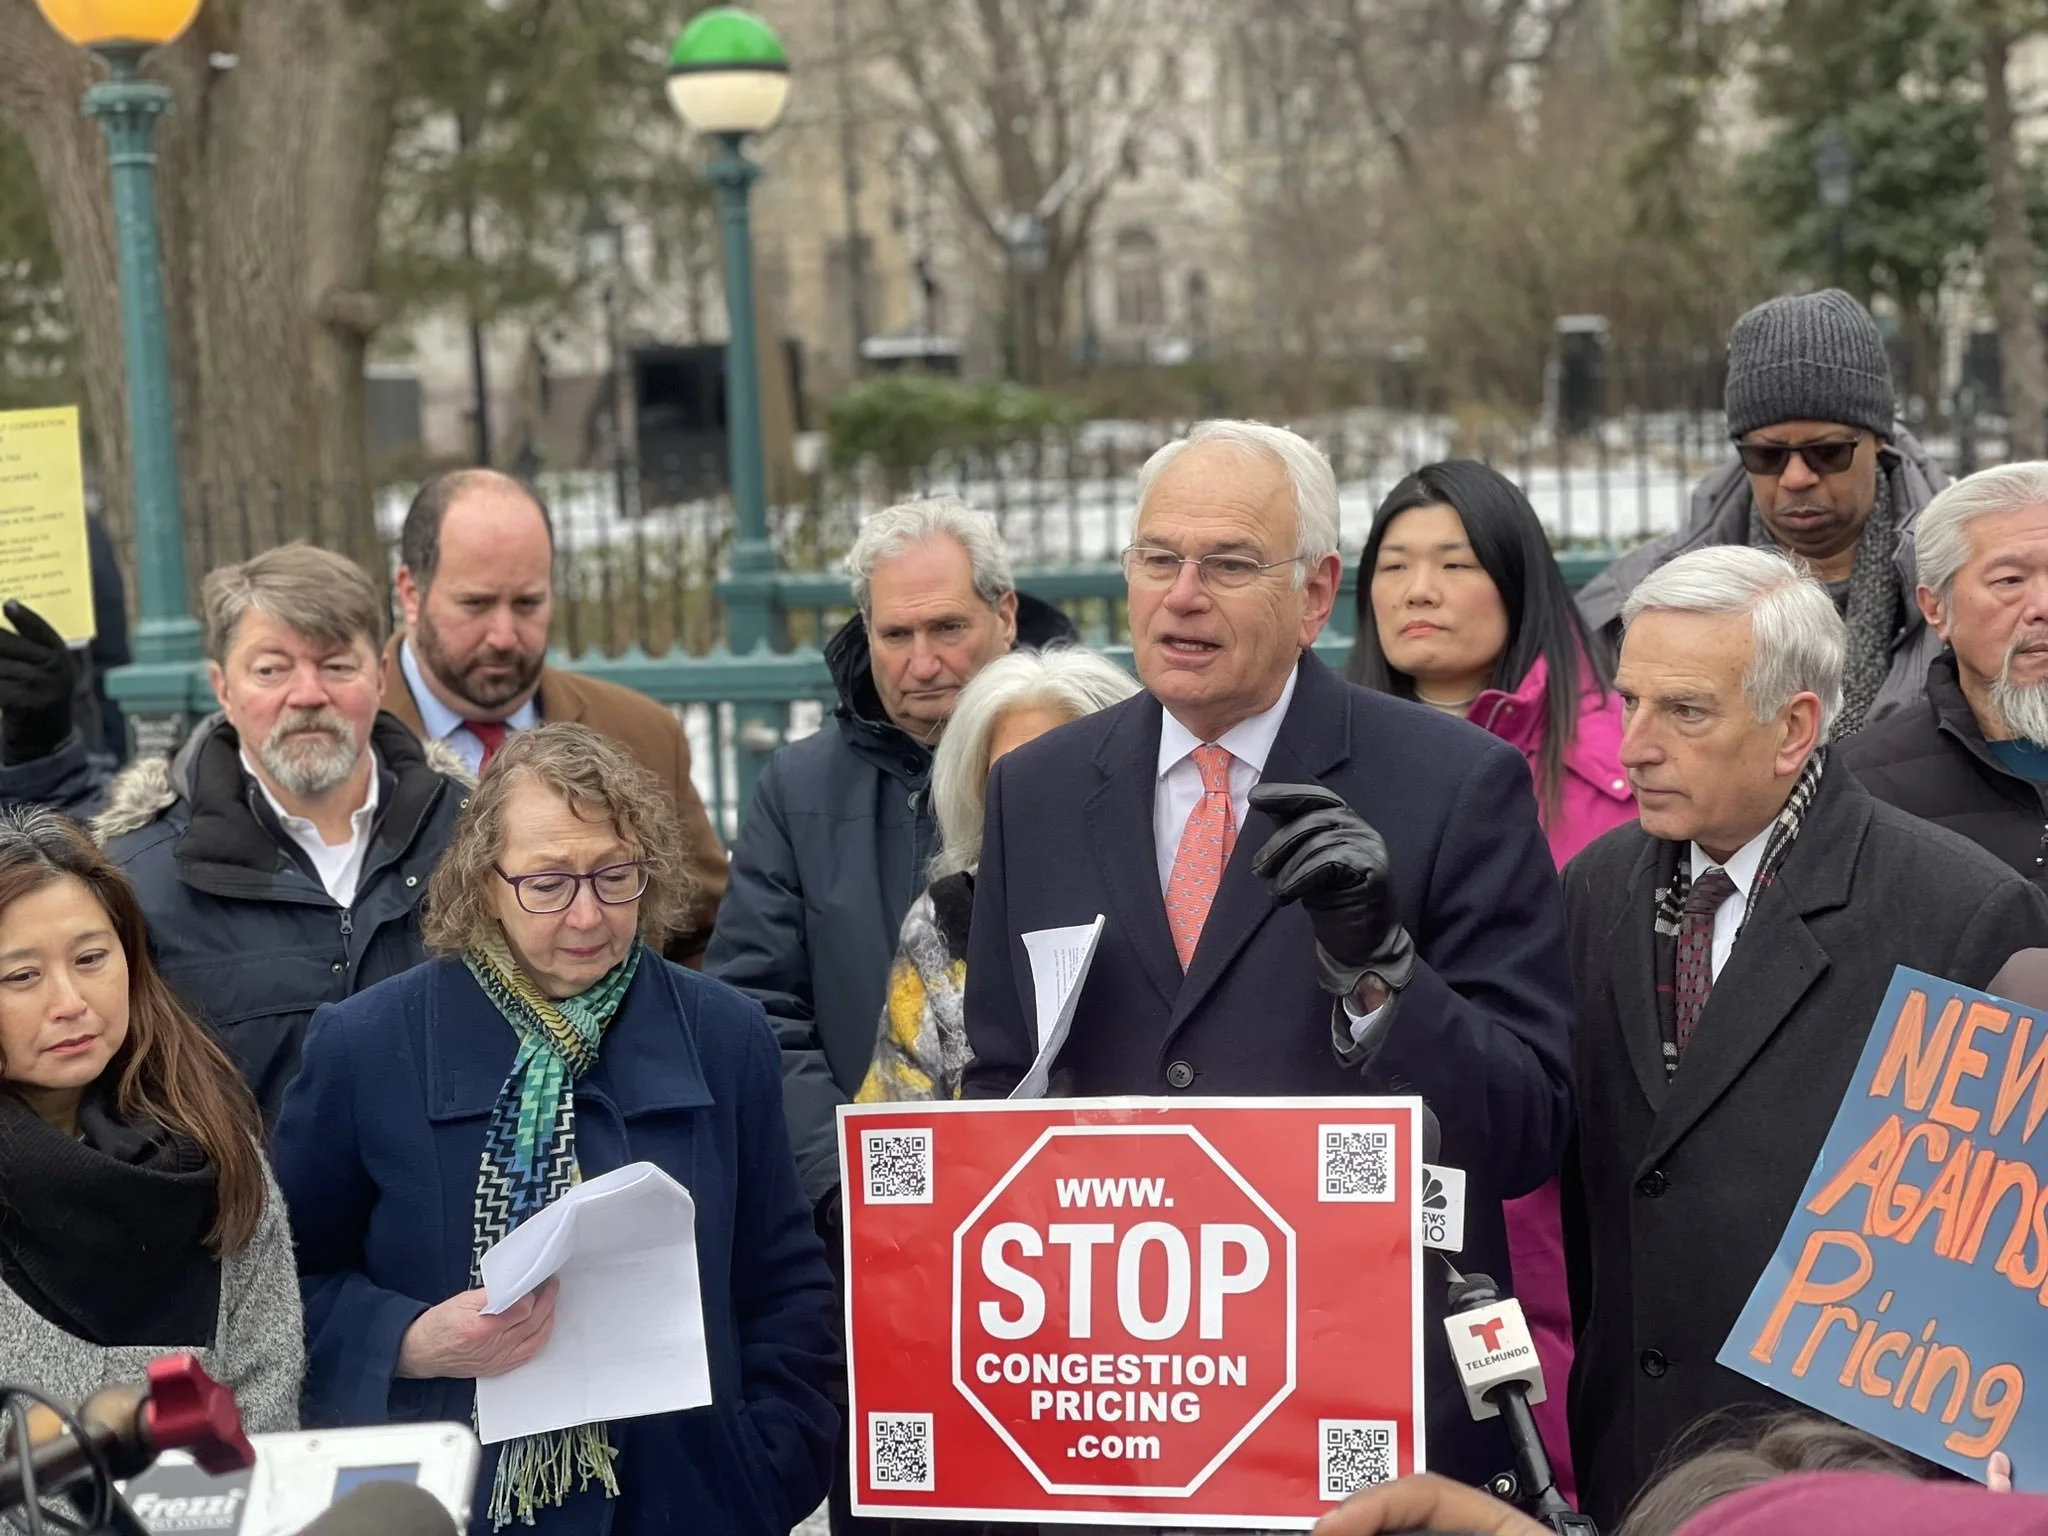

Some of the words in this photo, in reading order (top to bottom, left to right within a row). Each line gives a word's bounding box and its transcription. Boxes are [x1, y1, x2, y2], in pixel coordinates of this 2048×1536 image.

[1421, 1211, 1447, 1226] EWS
[978, 1221, 1270, 1341] STOP
[1465, 1345, 1530, 1371] TELEMUNDO
[1748, 1228, 2025, 1459] Pricing
[977, 1354, 1246, 1386] CONGESTION
[1032, 1390, 1200, 1422] PRICING
[1068, 1436, 1160, 1459] .com
[132, 1488, 246, 1519] Frezzi
